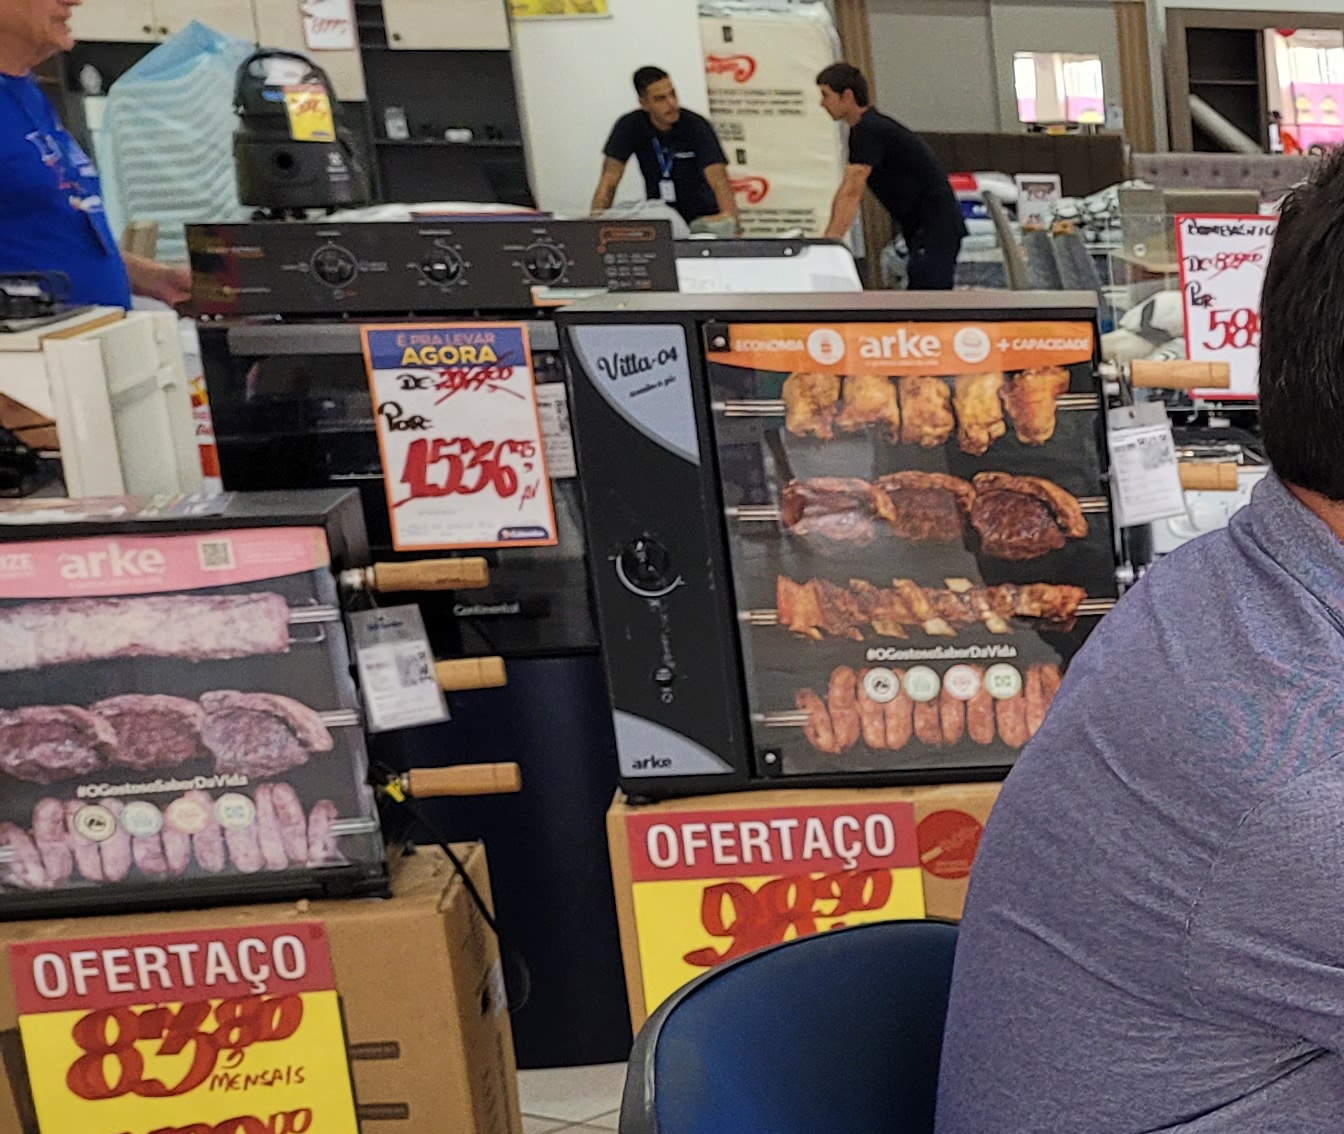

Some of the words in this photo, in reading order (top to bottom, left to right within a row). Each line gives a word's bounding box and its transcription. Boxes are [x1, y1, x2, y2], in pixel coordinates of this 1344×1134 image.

[444, 332, 496, 345] LEVAR
[858, 328, 943, 361] arke
[1012, 337, 1089, 352] CAPACIDADE
[401, 345, 497, 365] AGORA
[59, 543, 166, 579] arke
[631, 755, 672, 771] arke
[646, 812, 896, 871] OFERTAÇO
[31, 934, 307, 995] OFERTAÇO
[209, 1066, 305, 1091] MENSAIS
